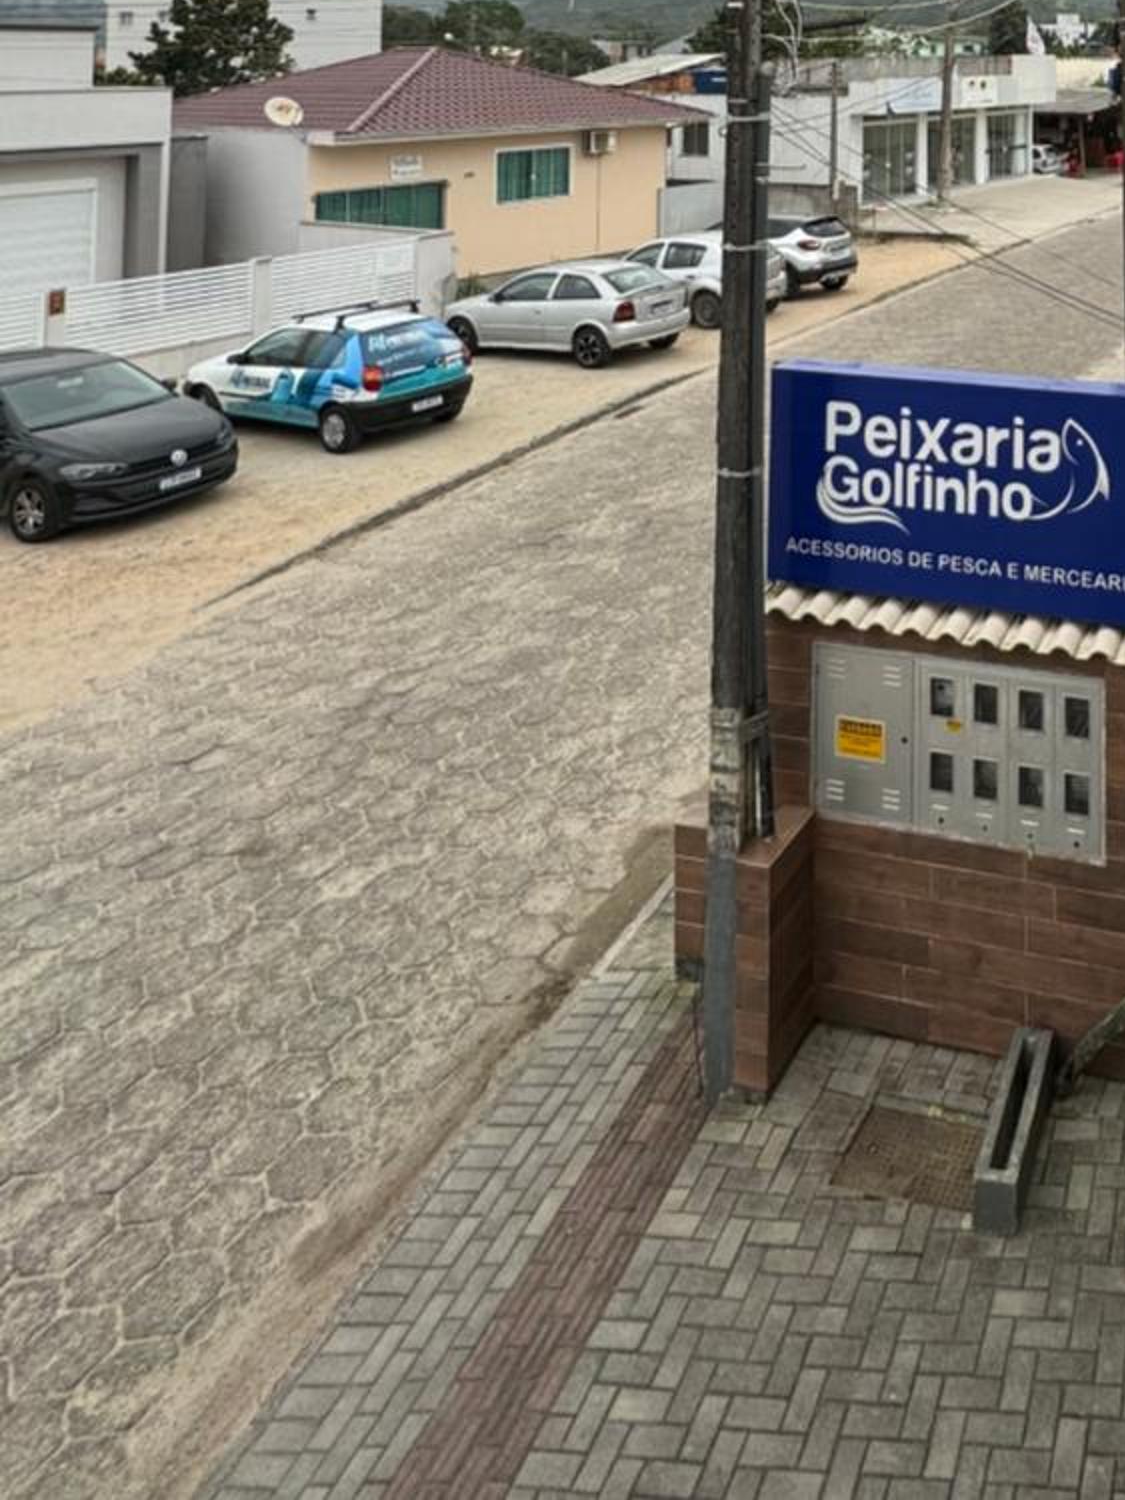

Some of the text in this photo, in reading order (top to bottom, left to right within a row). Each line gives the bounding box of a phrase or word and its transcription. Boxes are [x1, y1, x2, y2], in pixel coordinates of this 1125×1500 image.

[825, 400, 1060, 473] Peixaria
[823, 456, 1033, 521] Golfinho
[908, 550, 933, 569] DE
[938, 553, 1002, 578] PESCA
[1007, 561, 1019, 579] E
